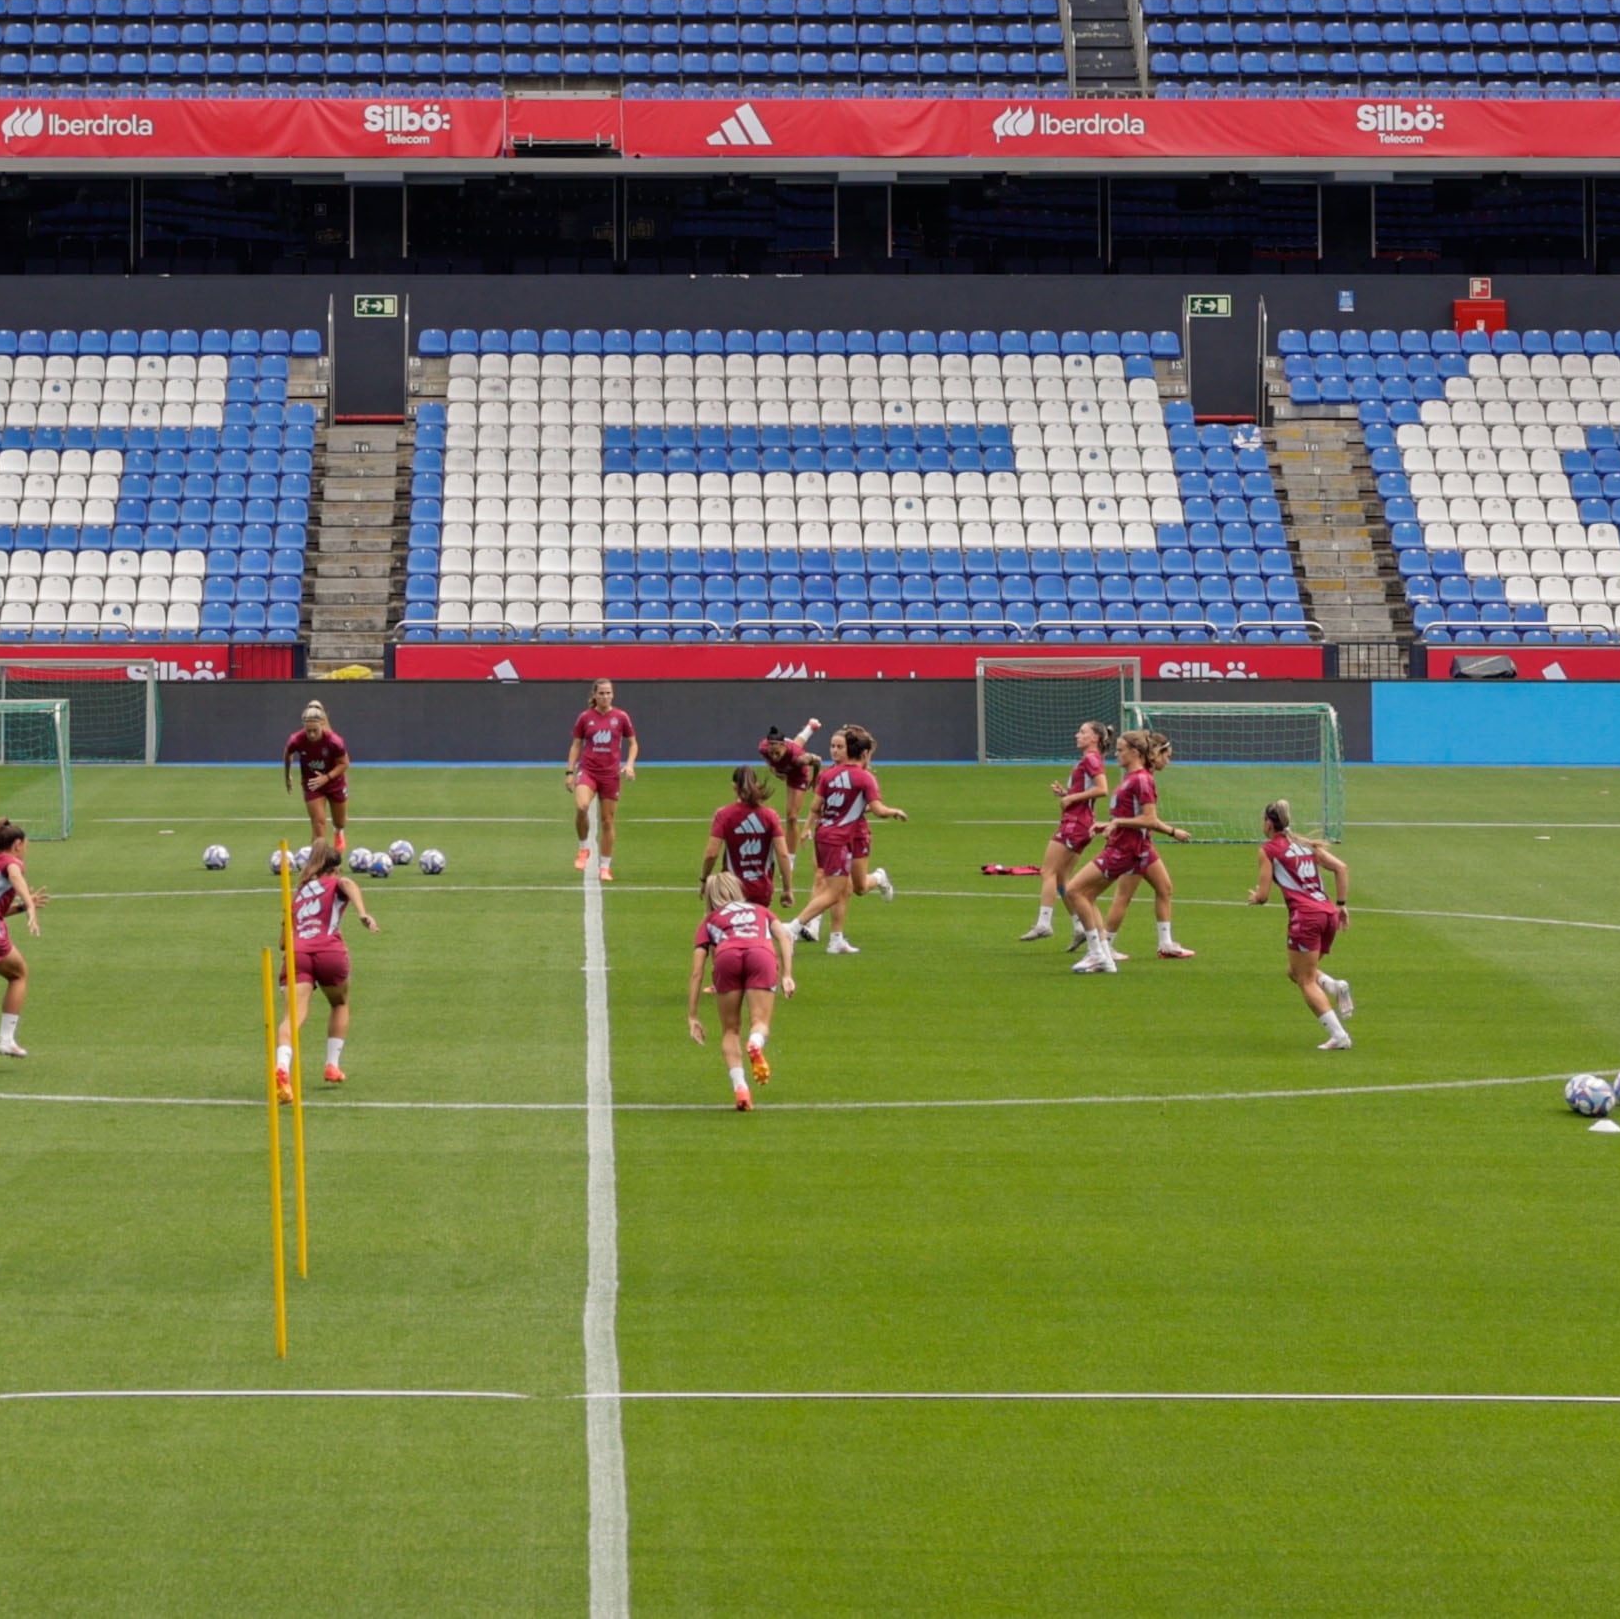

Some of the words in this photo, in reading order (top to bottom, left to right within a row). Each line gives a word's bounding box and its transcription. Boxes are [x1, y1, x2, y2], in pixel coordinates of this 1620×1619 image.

[48, 113, 153, 136] Iberdrola
[1039, 112, 1145, 135] Iberdrola
[385, 133, 431, 145] Telecom
[1377, 132, 1424, 144] Telecom
